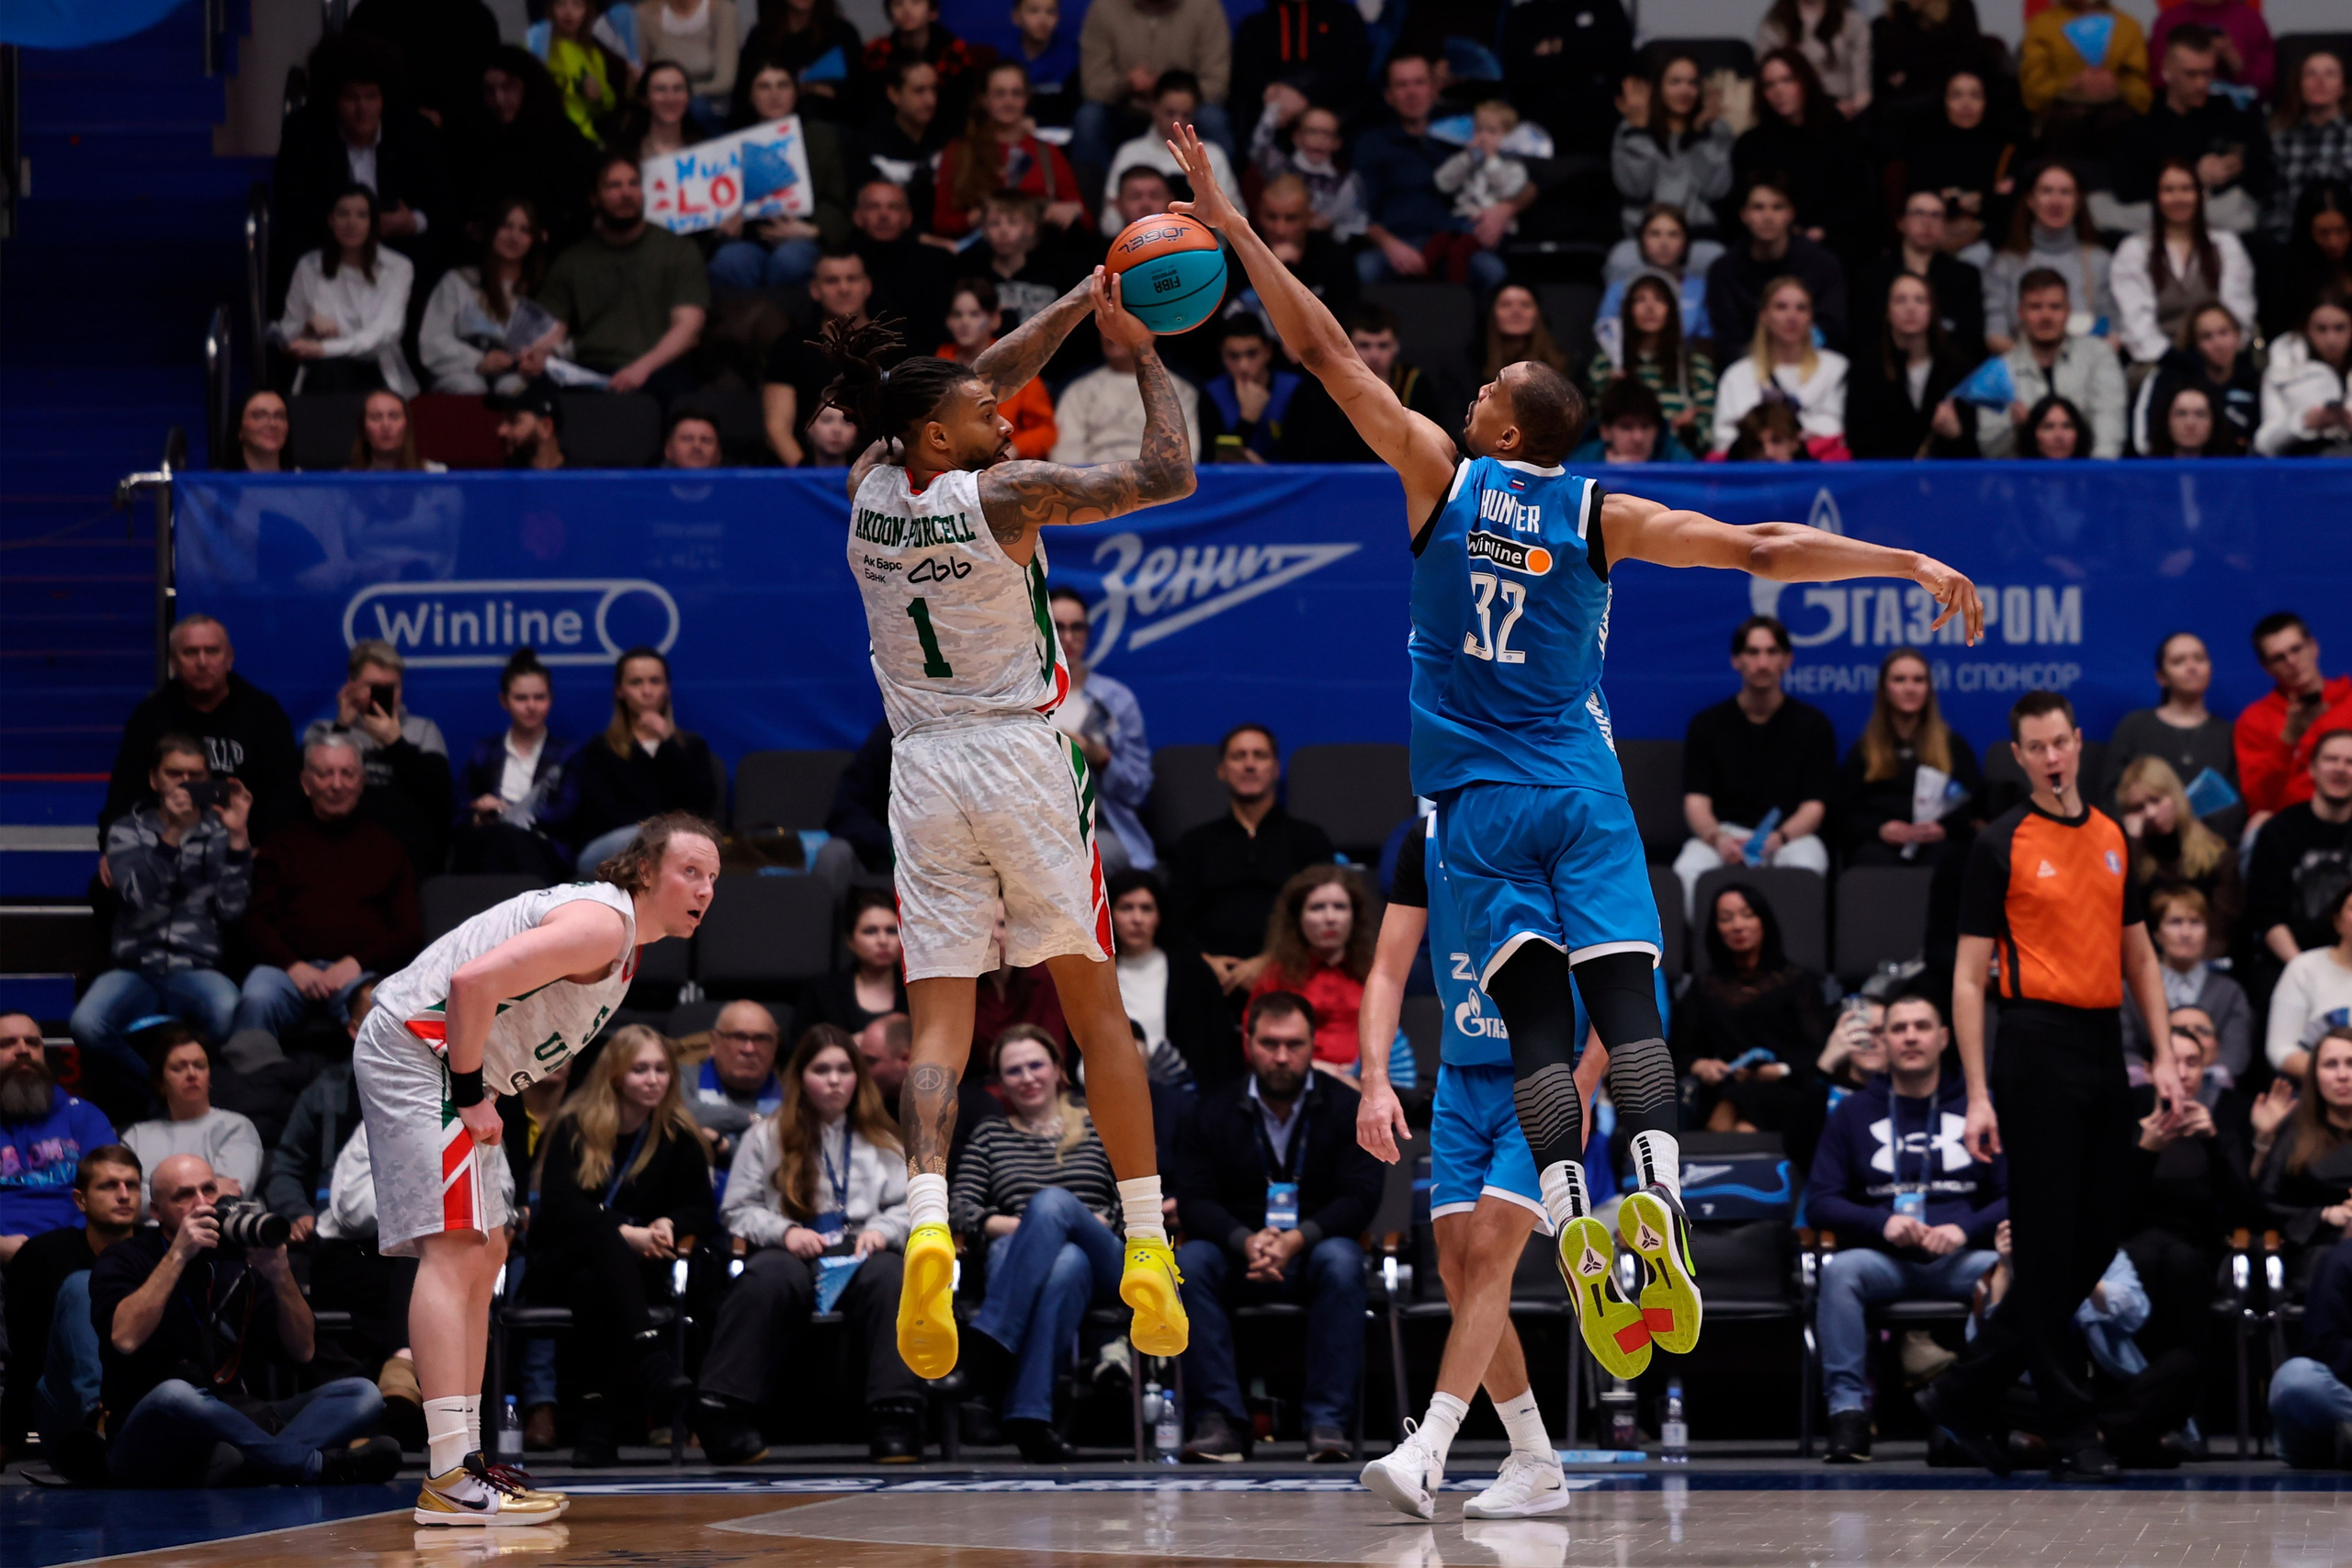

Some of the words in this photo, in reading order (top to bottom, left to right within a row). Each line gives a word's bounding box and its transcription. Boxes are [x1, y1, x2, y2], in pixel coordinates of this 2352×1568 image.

[1153, 276, 1182, 294] FIBA
[855, 506, 977, 548] AKOON-PURCELL
[864, 554, 875, 567] Ак
[876, 557, 902, 572] Барс
[865, 568, 887, 584] Банк
[374, 600, 583, 648] Winline
[1463, 570, 1527, 664] 32
[905, 597, 954, 678] 1
[1956, 663, 2081, 692] СПОНСОР
